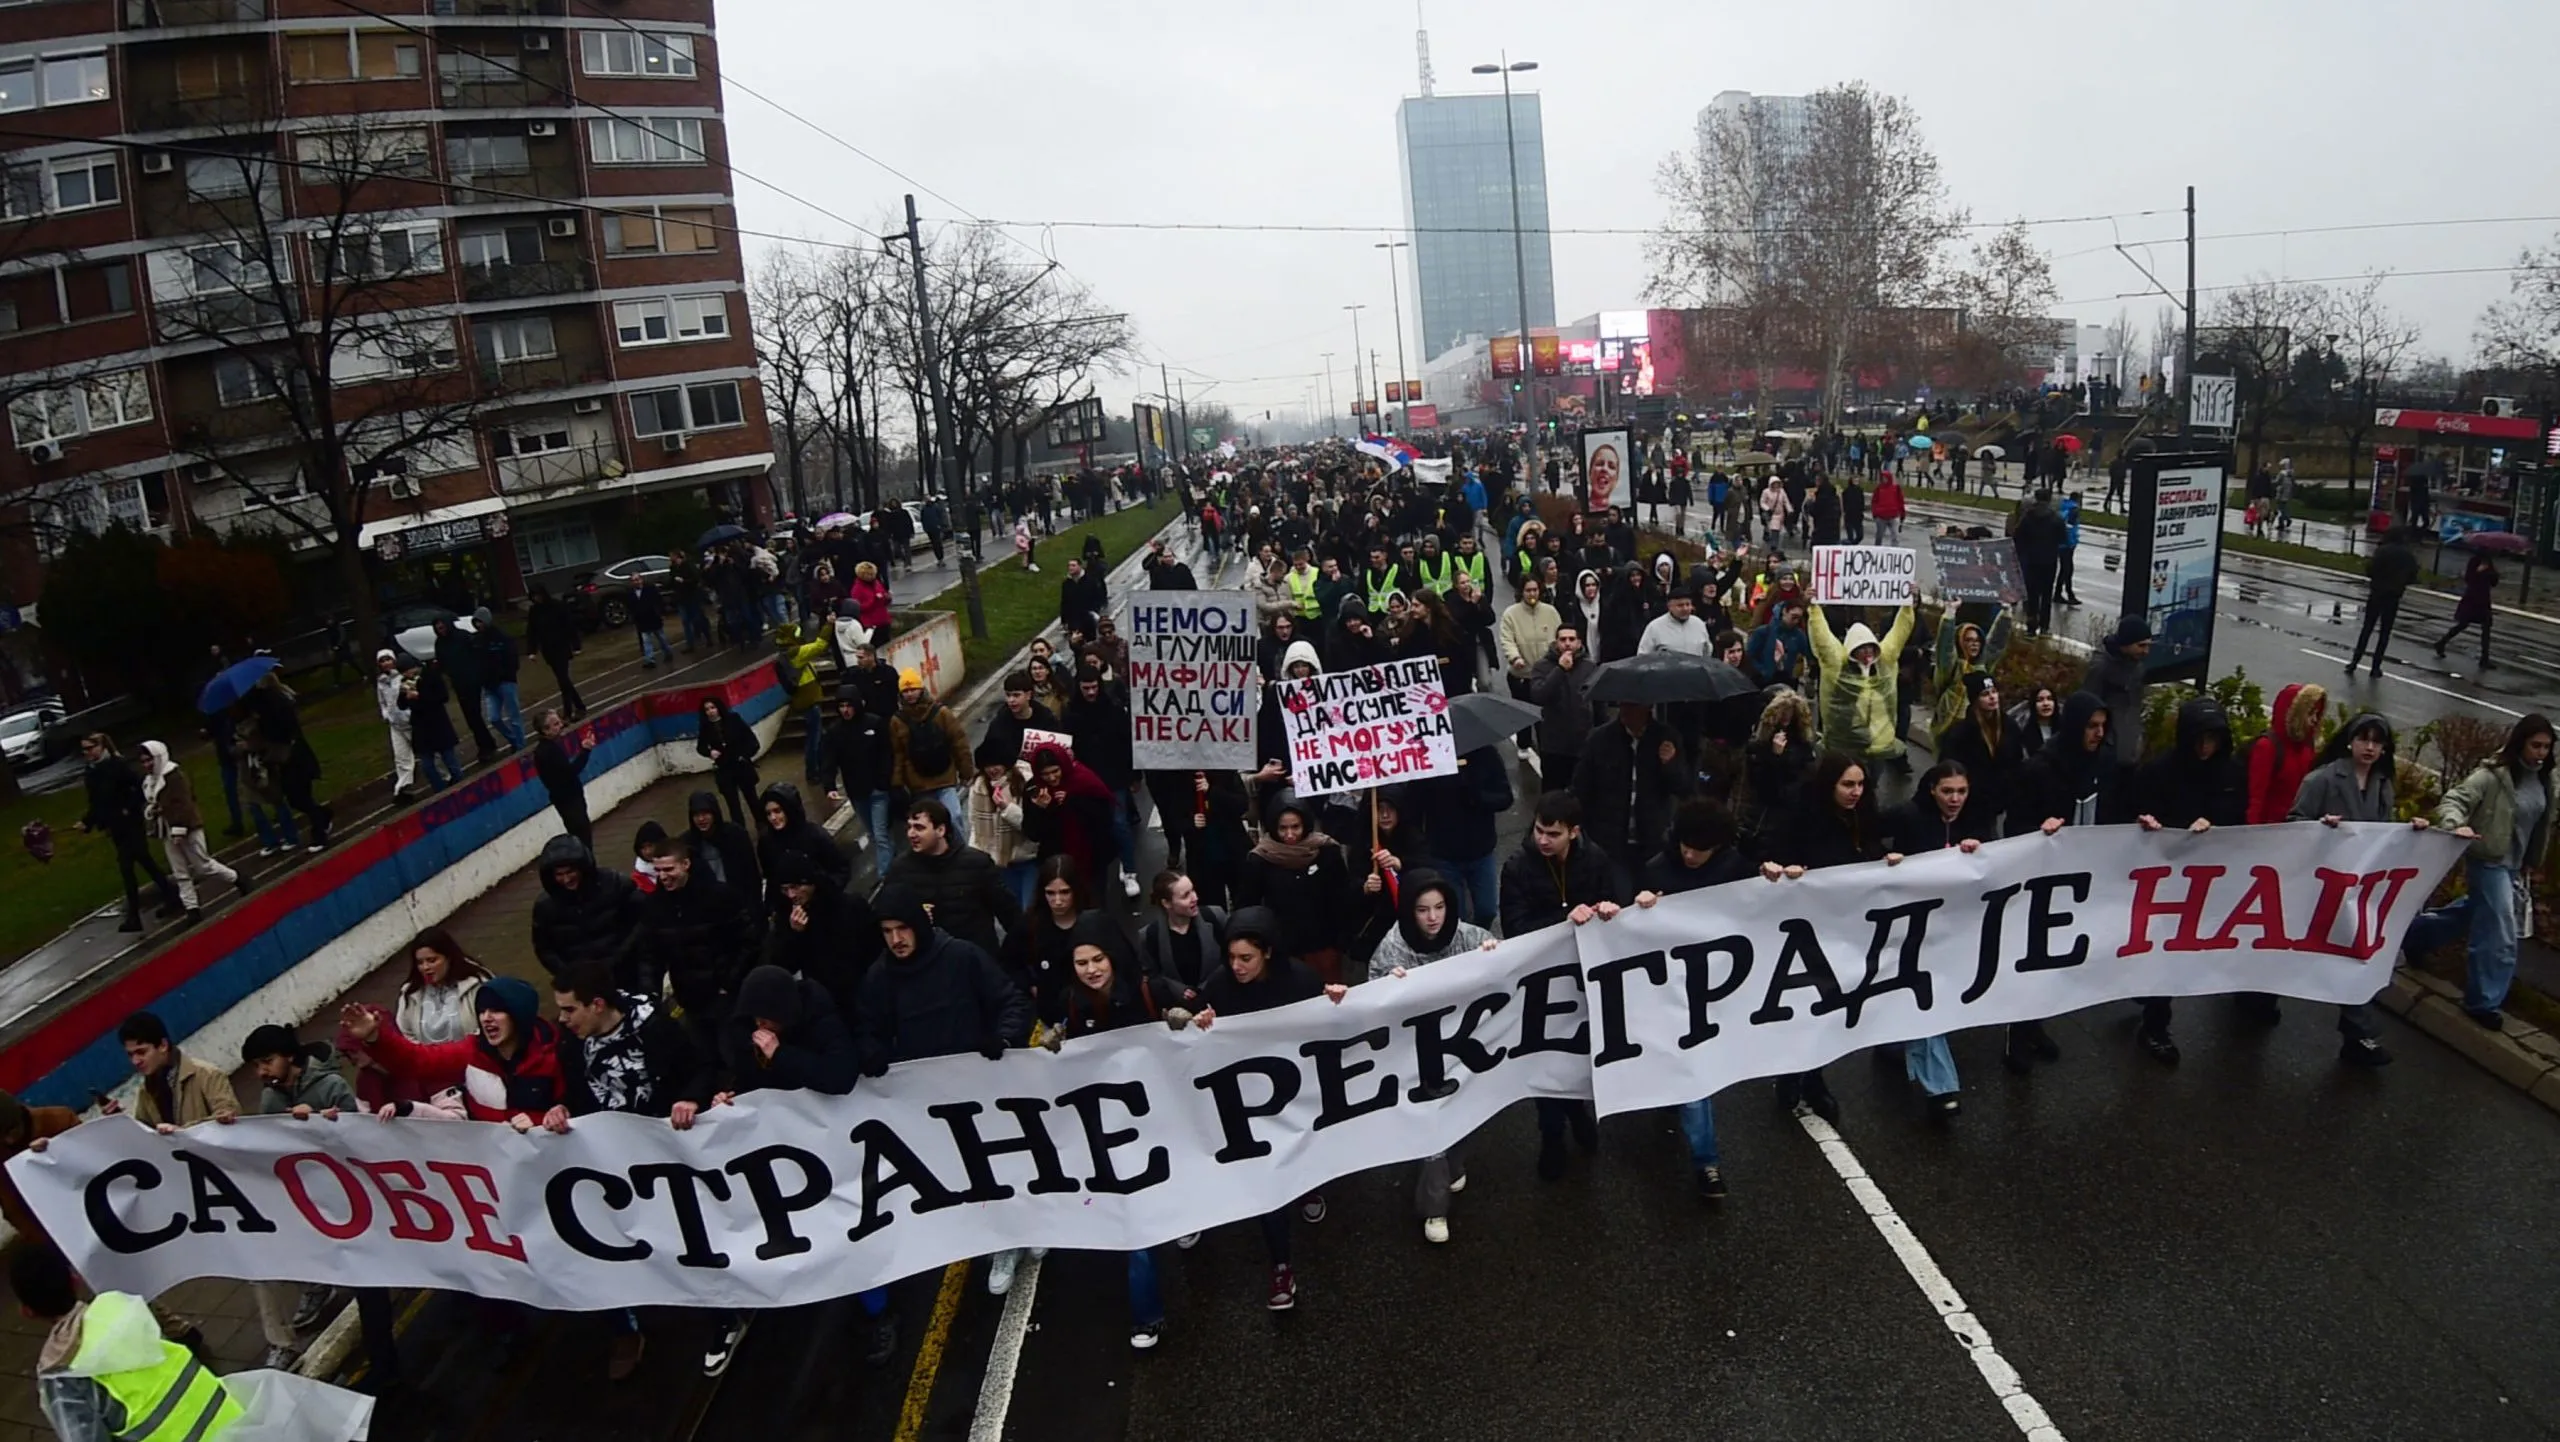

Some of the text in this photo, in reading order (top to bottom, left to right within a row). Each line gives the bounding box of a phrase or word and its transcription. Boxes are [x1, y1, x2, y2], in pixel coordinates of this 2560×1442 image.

[2187, 504, 2217, 518] ПРЕВОЗ
[1842, 579, 1913, 600] МОРАЛНО
[1133, 606, 1248, 634] НЕМОЈ
[1133, 635, 1256, 662] ДА ГЛУМИШ
[1131, 661, 1252, 689] МАФИЈУ
[1384, 660, 1440, 689] ПЛЕН
[1143, 688, 1245, 716] КАД СИ
[1297, 692, 1413, 738] ДА СКУПЕ
[1135, 716, 1250, 742] ПЕСАК!
[1295, 713, 1453, 761] НЕ МОГУ ДА
[1308, 746, 1433, 792] НАС КУПЕ
[83, 865, 2419, 1268] СА ОБЕ СТРАНЕ РЕКЕ ГРАД ЈЕ НАШ
